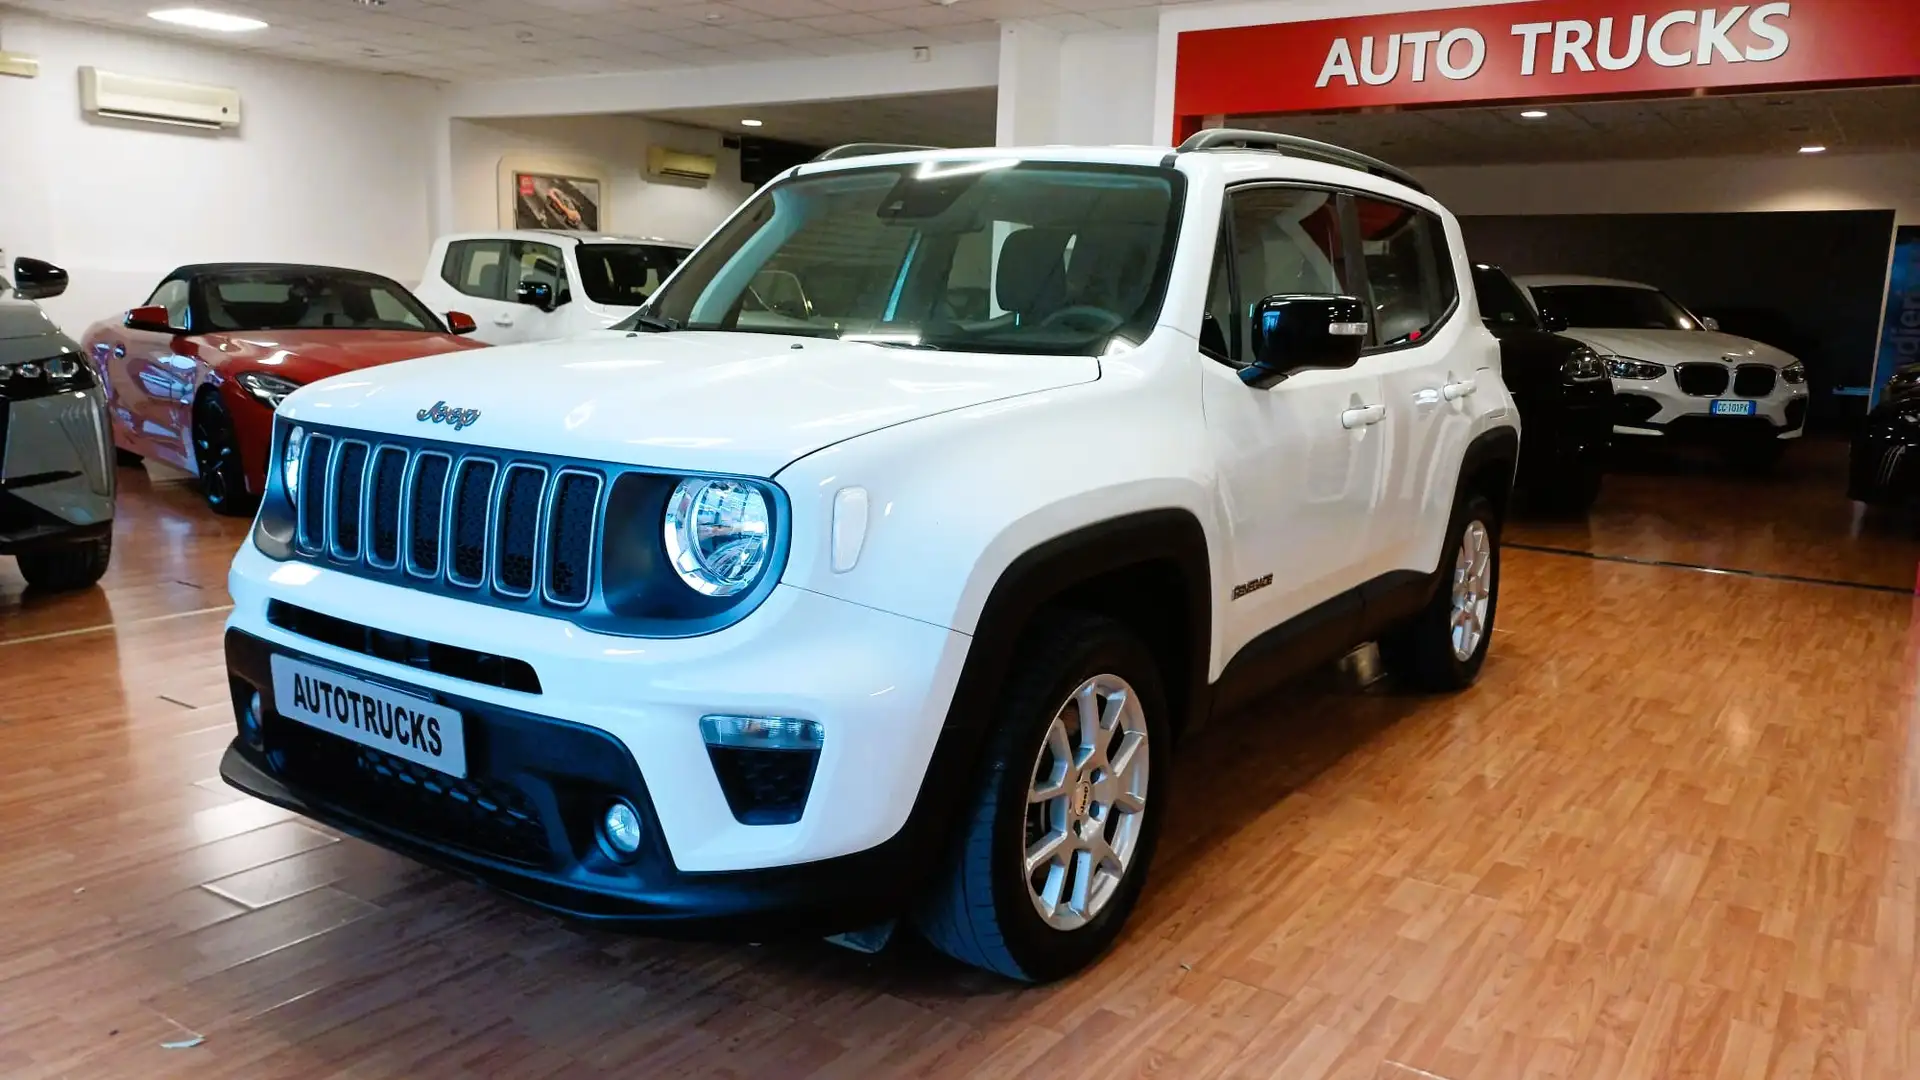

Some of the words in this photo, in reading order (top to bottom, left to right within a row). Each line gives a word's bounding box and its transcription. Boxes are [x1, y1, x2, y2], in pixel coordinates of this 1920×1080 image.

[1315, 27, 1486, 89] AUTO
[1511, 3, 1790, 76] TRUCKS
[416, 400, 481, 431] Jeep
[1231, 572, 1273, 601] RENEGADE
[293, 672, 443, 757] AUTOTRUCKS
